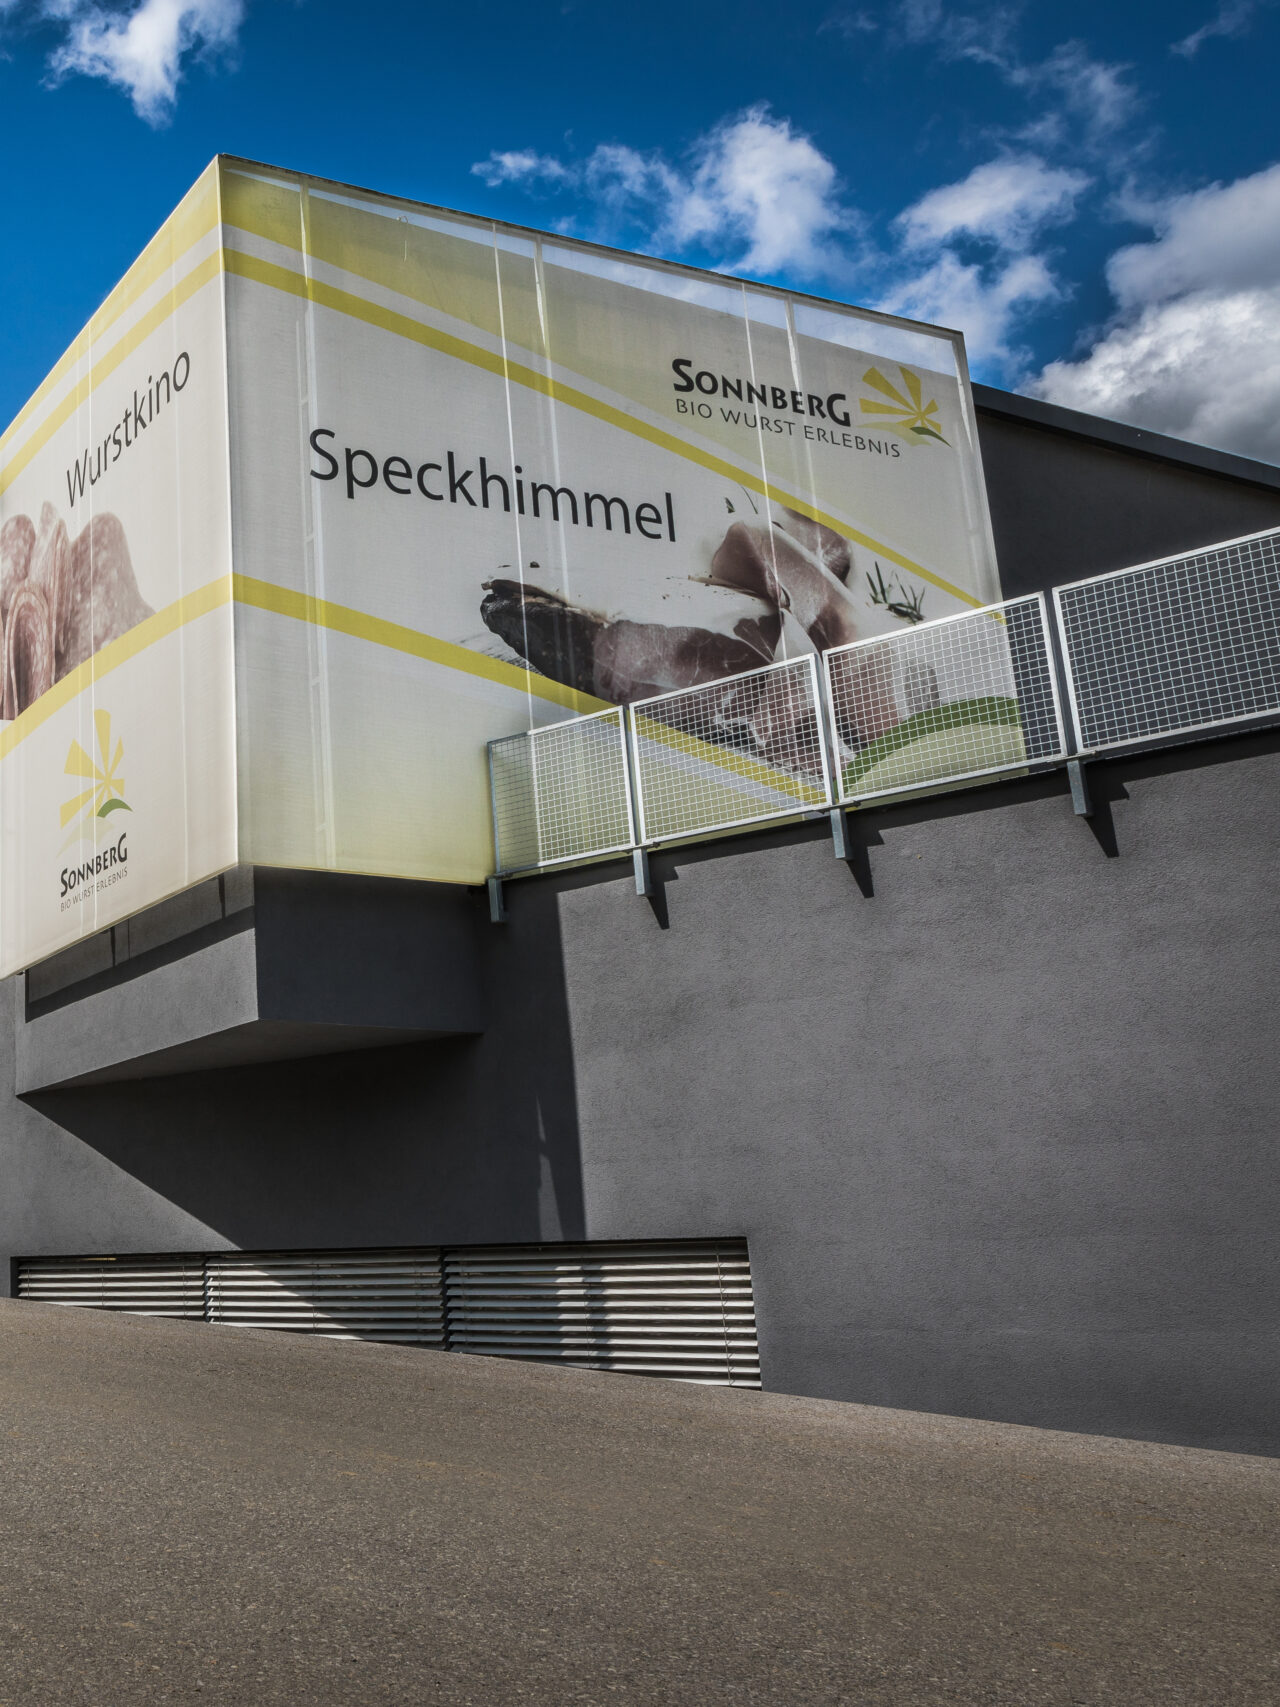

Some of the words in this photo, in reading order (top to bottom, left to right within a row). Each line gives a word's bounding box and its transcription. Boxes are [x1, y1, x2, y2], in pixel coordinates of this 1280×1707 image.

[672, 358, 851, 428] SONNBERG
[66, 351, 190, 508] Wurstkino
[676, 398, 712, 419] BIO
[720, 407, 796, 436] WURST
[804, 425, 901, 458] ERLEBNIS
[309, 428, 677, 543] Speckhimmel
[60, 832, 128, 898] SONNBERG
[60, 898, 72, 913] BIO
[72, 885, 95, 905] WURST
[96, 866, 128, 892] ERLEBNIS
